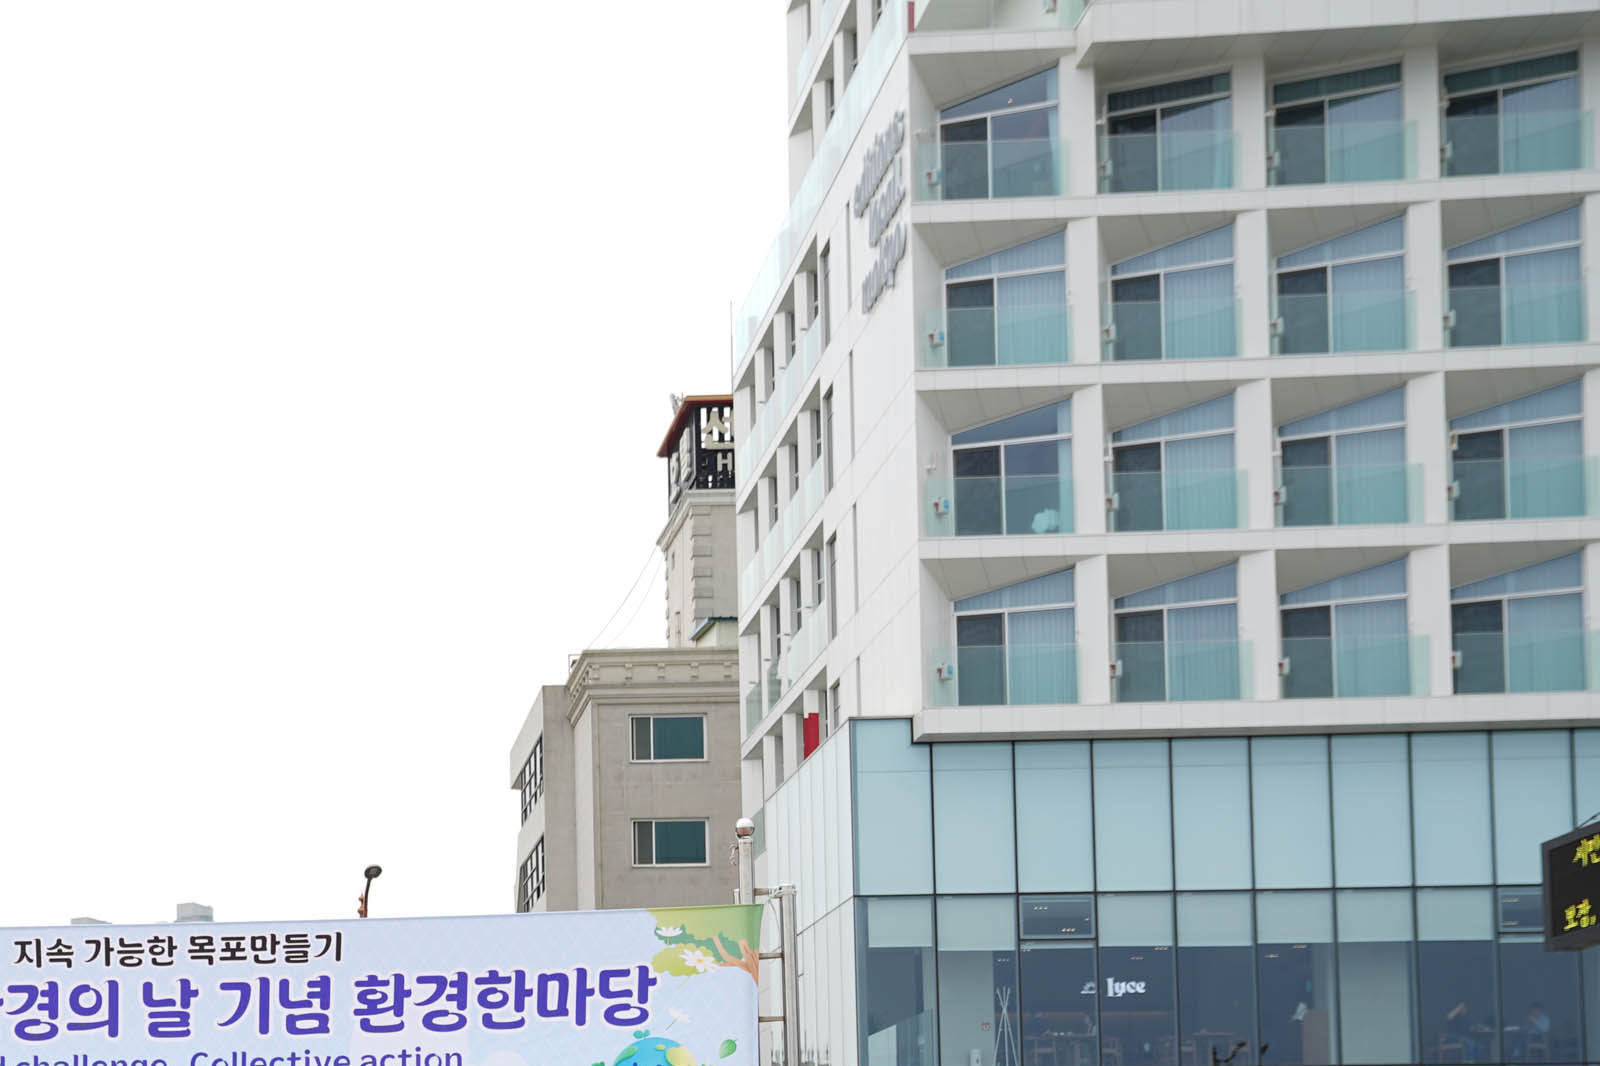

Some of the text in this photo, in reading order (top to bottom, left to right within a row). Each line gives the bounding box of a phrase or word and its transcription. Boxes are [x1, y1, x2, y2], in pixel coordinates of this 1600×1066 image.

[13, 931, 343, 969] 지속 가능한 목포만들기
[142, 976, 199, 1038] 날
[217, 974, 331, 1038] 기념
[353, 963, 658, 1034] 환경한마당
